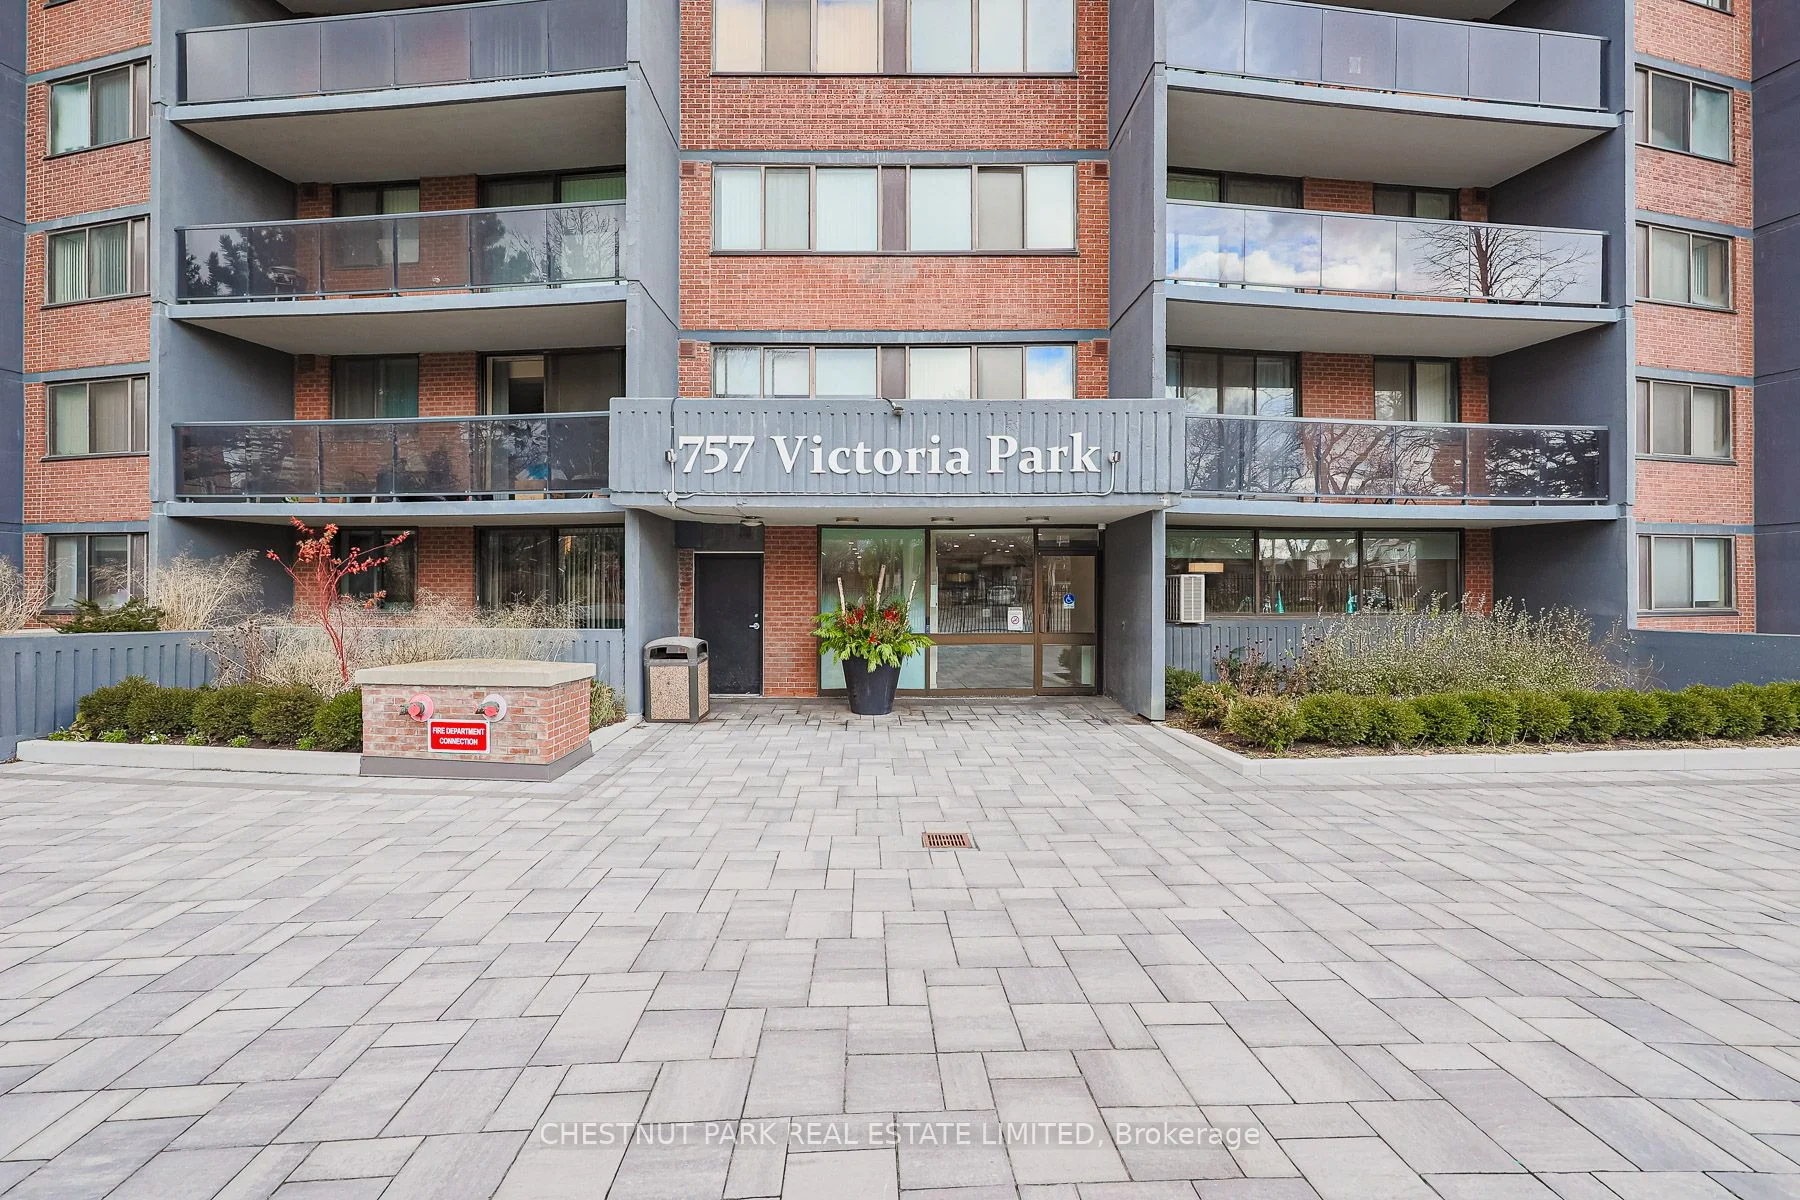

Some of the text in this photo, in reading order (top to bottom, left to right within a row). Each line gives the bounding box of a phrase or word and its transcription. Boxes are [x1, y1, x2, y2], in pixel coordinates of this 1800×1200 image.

[679, 432, 1101, 475] 757 Victoria Park
[432, 727, 485, 736] FIRE DEPARTMENT
[439, 737, 478, 746] CONNECTION
